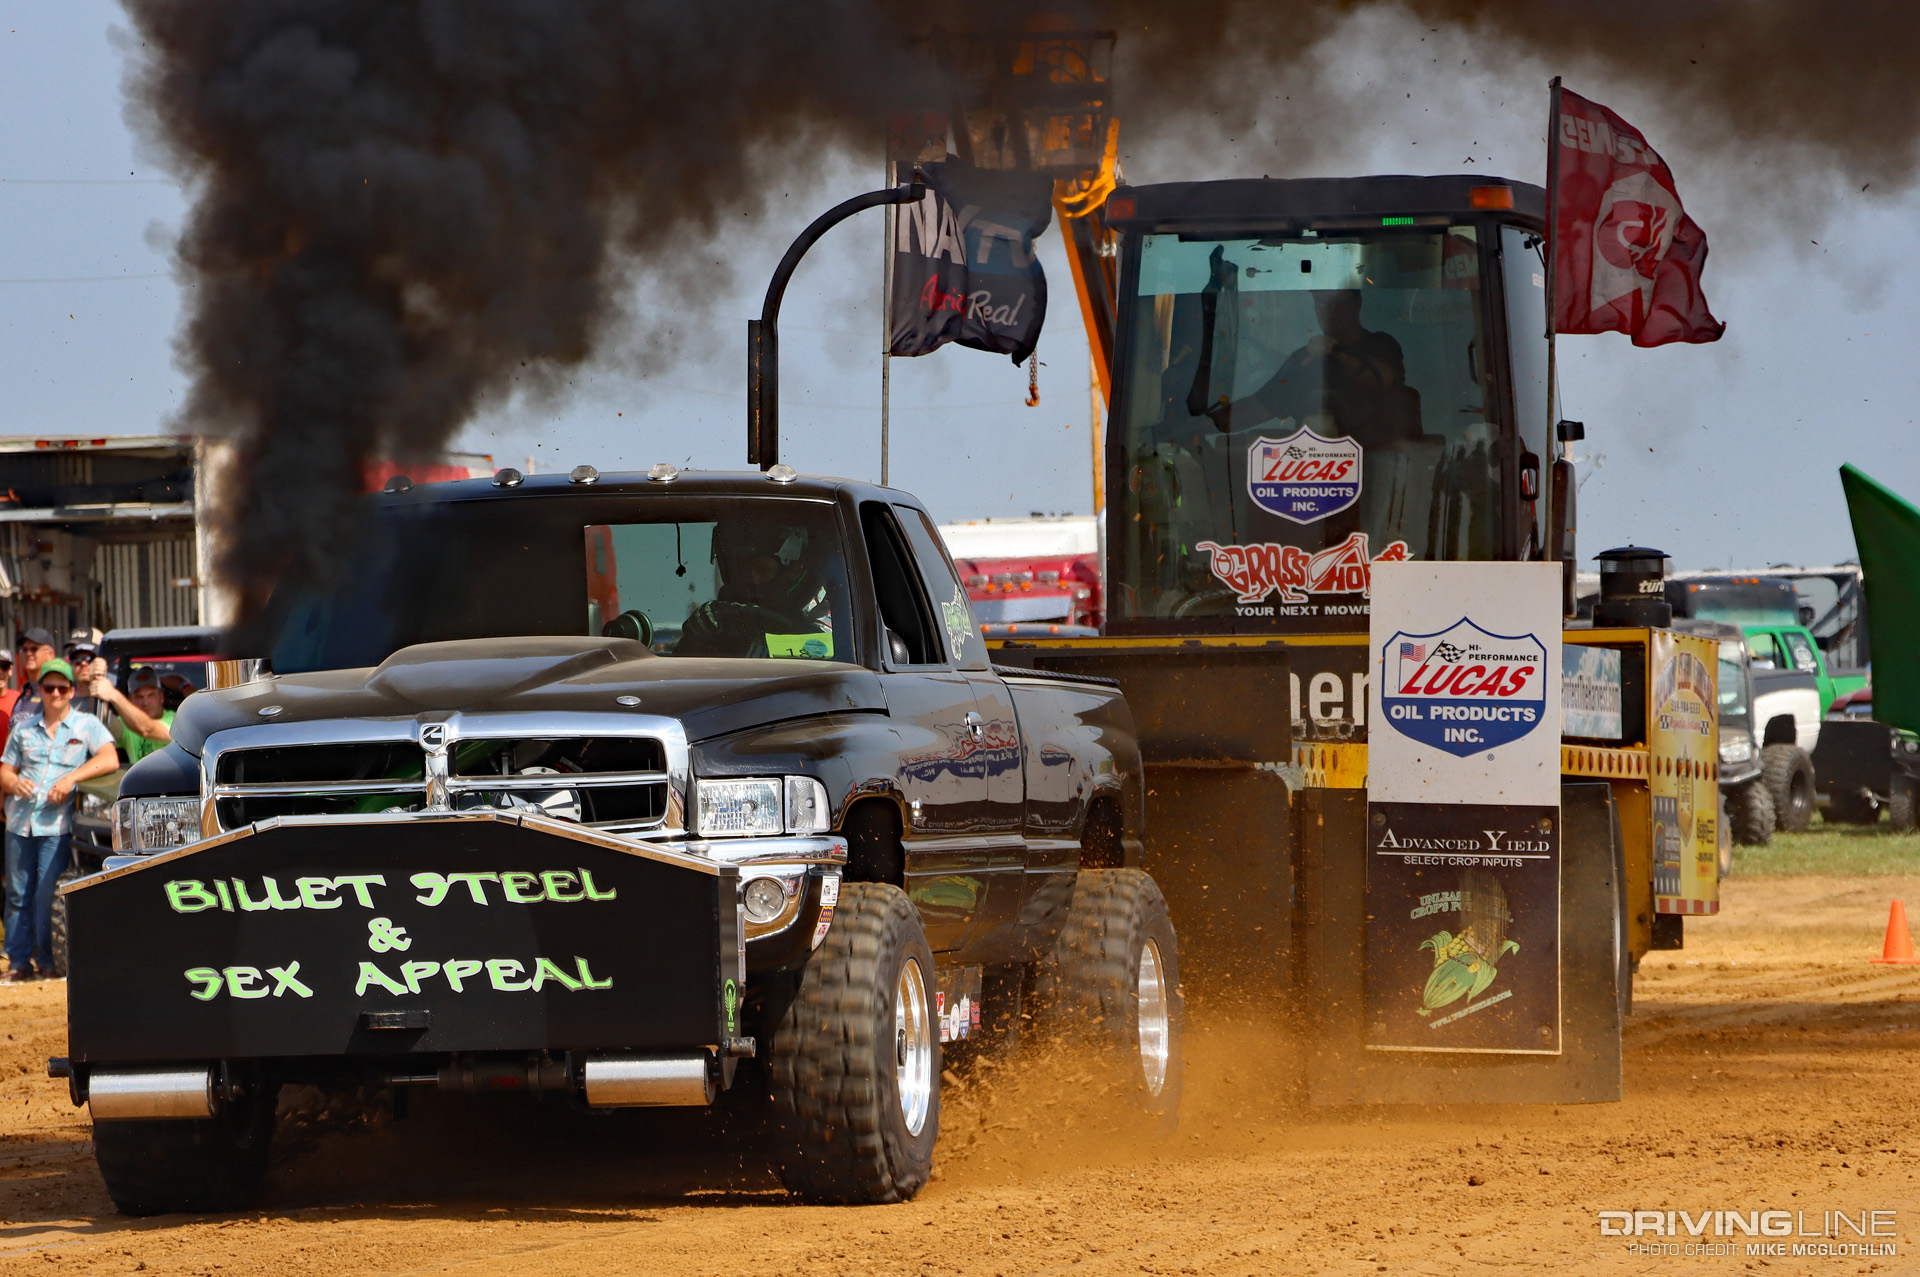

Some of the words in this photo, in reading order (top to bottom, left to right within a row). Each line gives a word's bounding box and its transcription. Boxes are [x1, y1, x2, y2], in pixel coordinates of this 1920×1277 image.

[967, 290, 1026, 327] Real.
[1264, 460, 1354, 481] LUCAS
[1256, 487, 1279, 497] OIL
[1283, 487, 1355, 498] PRODUCTS
[1292, 502, 1319, 512] INC.
[1235, 606, 1275, 617] YOUR
[1280, 606, 1319, 616] NEXT
[1468, 654, 1539, 662] PERFORMANCE
[1399, 664, 1535, 697] LUCAS
[1390, 705, 1423, 720] OIL
[1430, 706, 1536, 722] PRODUCTS
[1444, 728, 1484, 743] INC.
[1377, 828, 1480, 850] ADVANCED
[1483, 830, 1550, 852] YIELD
[1404, 856, 1446, 865] SELECT
[1448, 856, 1480, 866] CROP
[1482, 858, 1523, 868] INPUTS
[163, 875, 387, 914] BILLET
[409, 867, 617, 907] STEEL
[367, 917, 412, 953] &
[183, 960, 314, 1001] SEX
[355, 956, 613, 997] APPEAL
